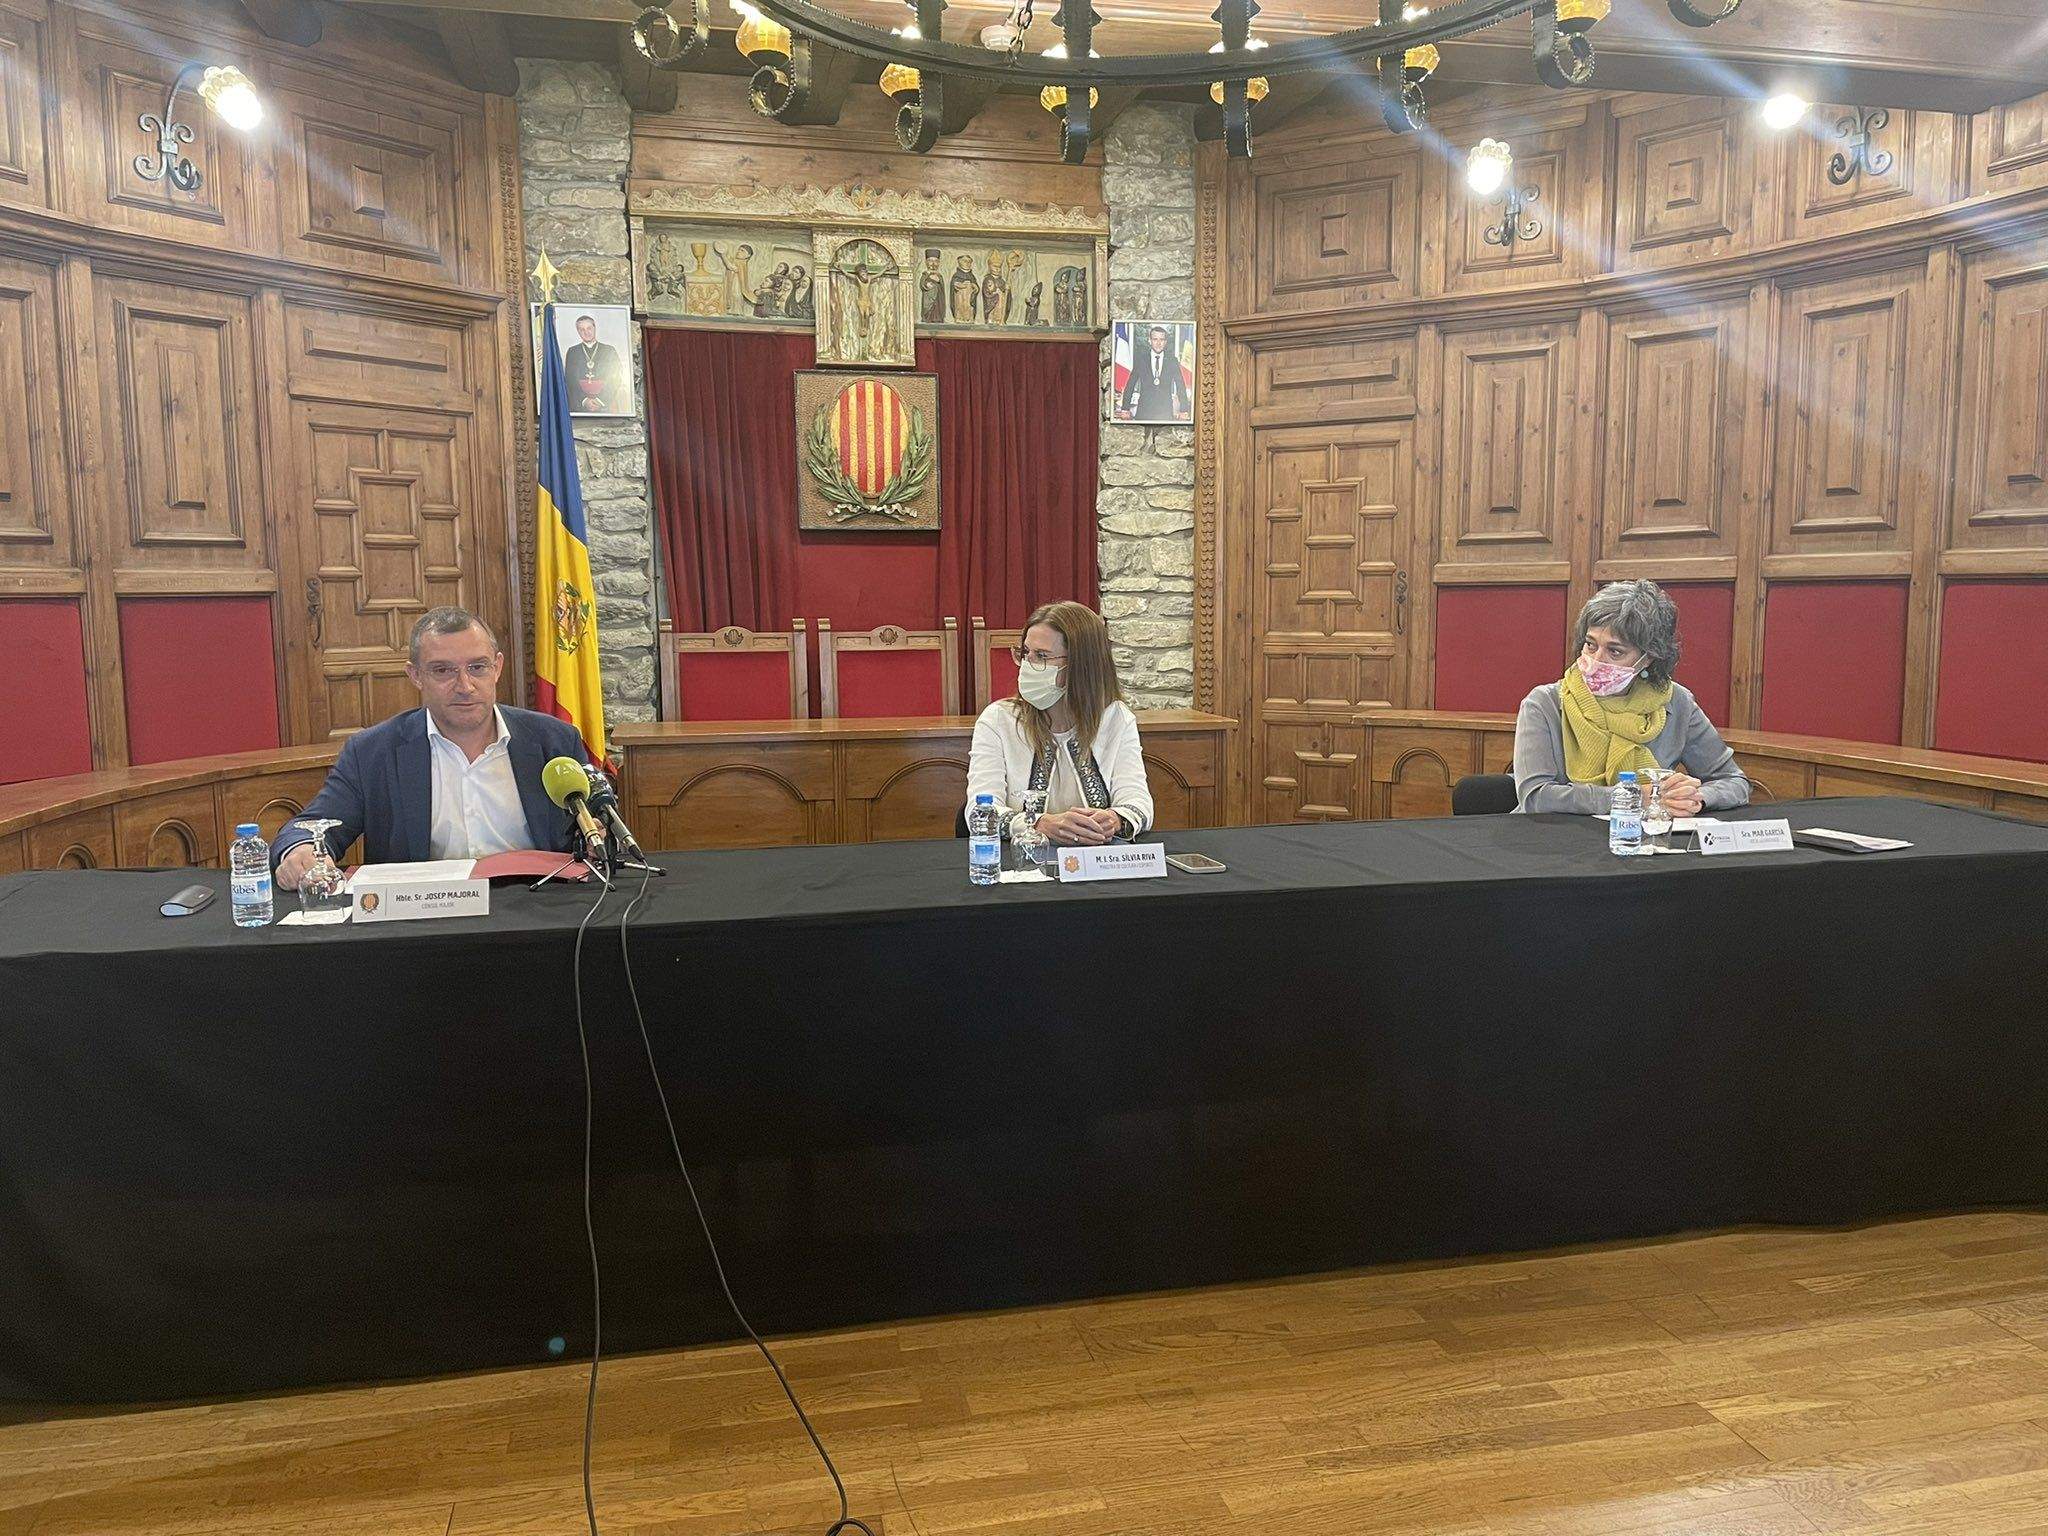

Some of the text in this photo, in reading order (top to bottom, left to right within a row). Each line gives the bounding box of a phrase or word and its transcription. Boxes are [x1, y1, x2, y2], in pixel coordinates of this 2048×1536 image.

[1141, 853, 1156, 861] RIVA
[424, 892, 447, 900] JOSEP
[447, 890, 480, 899] MAJORAL
